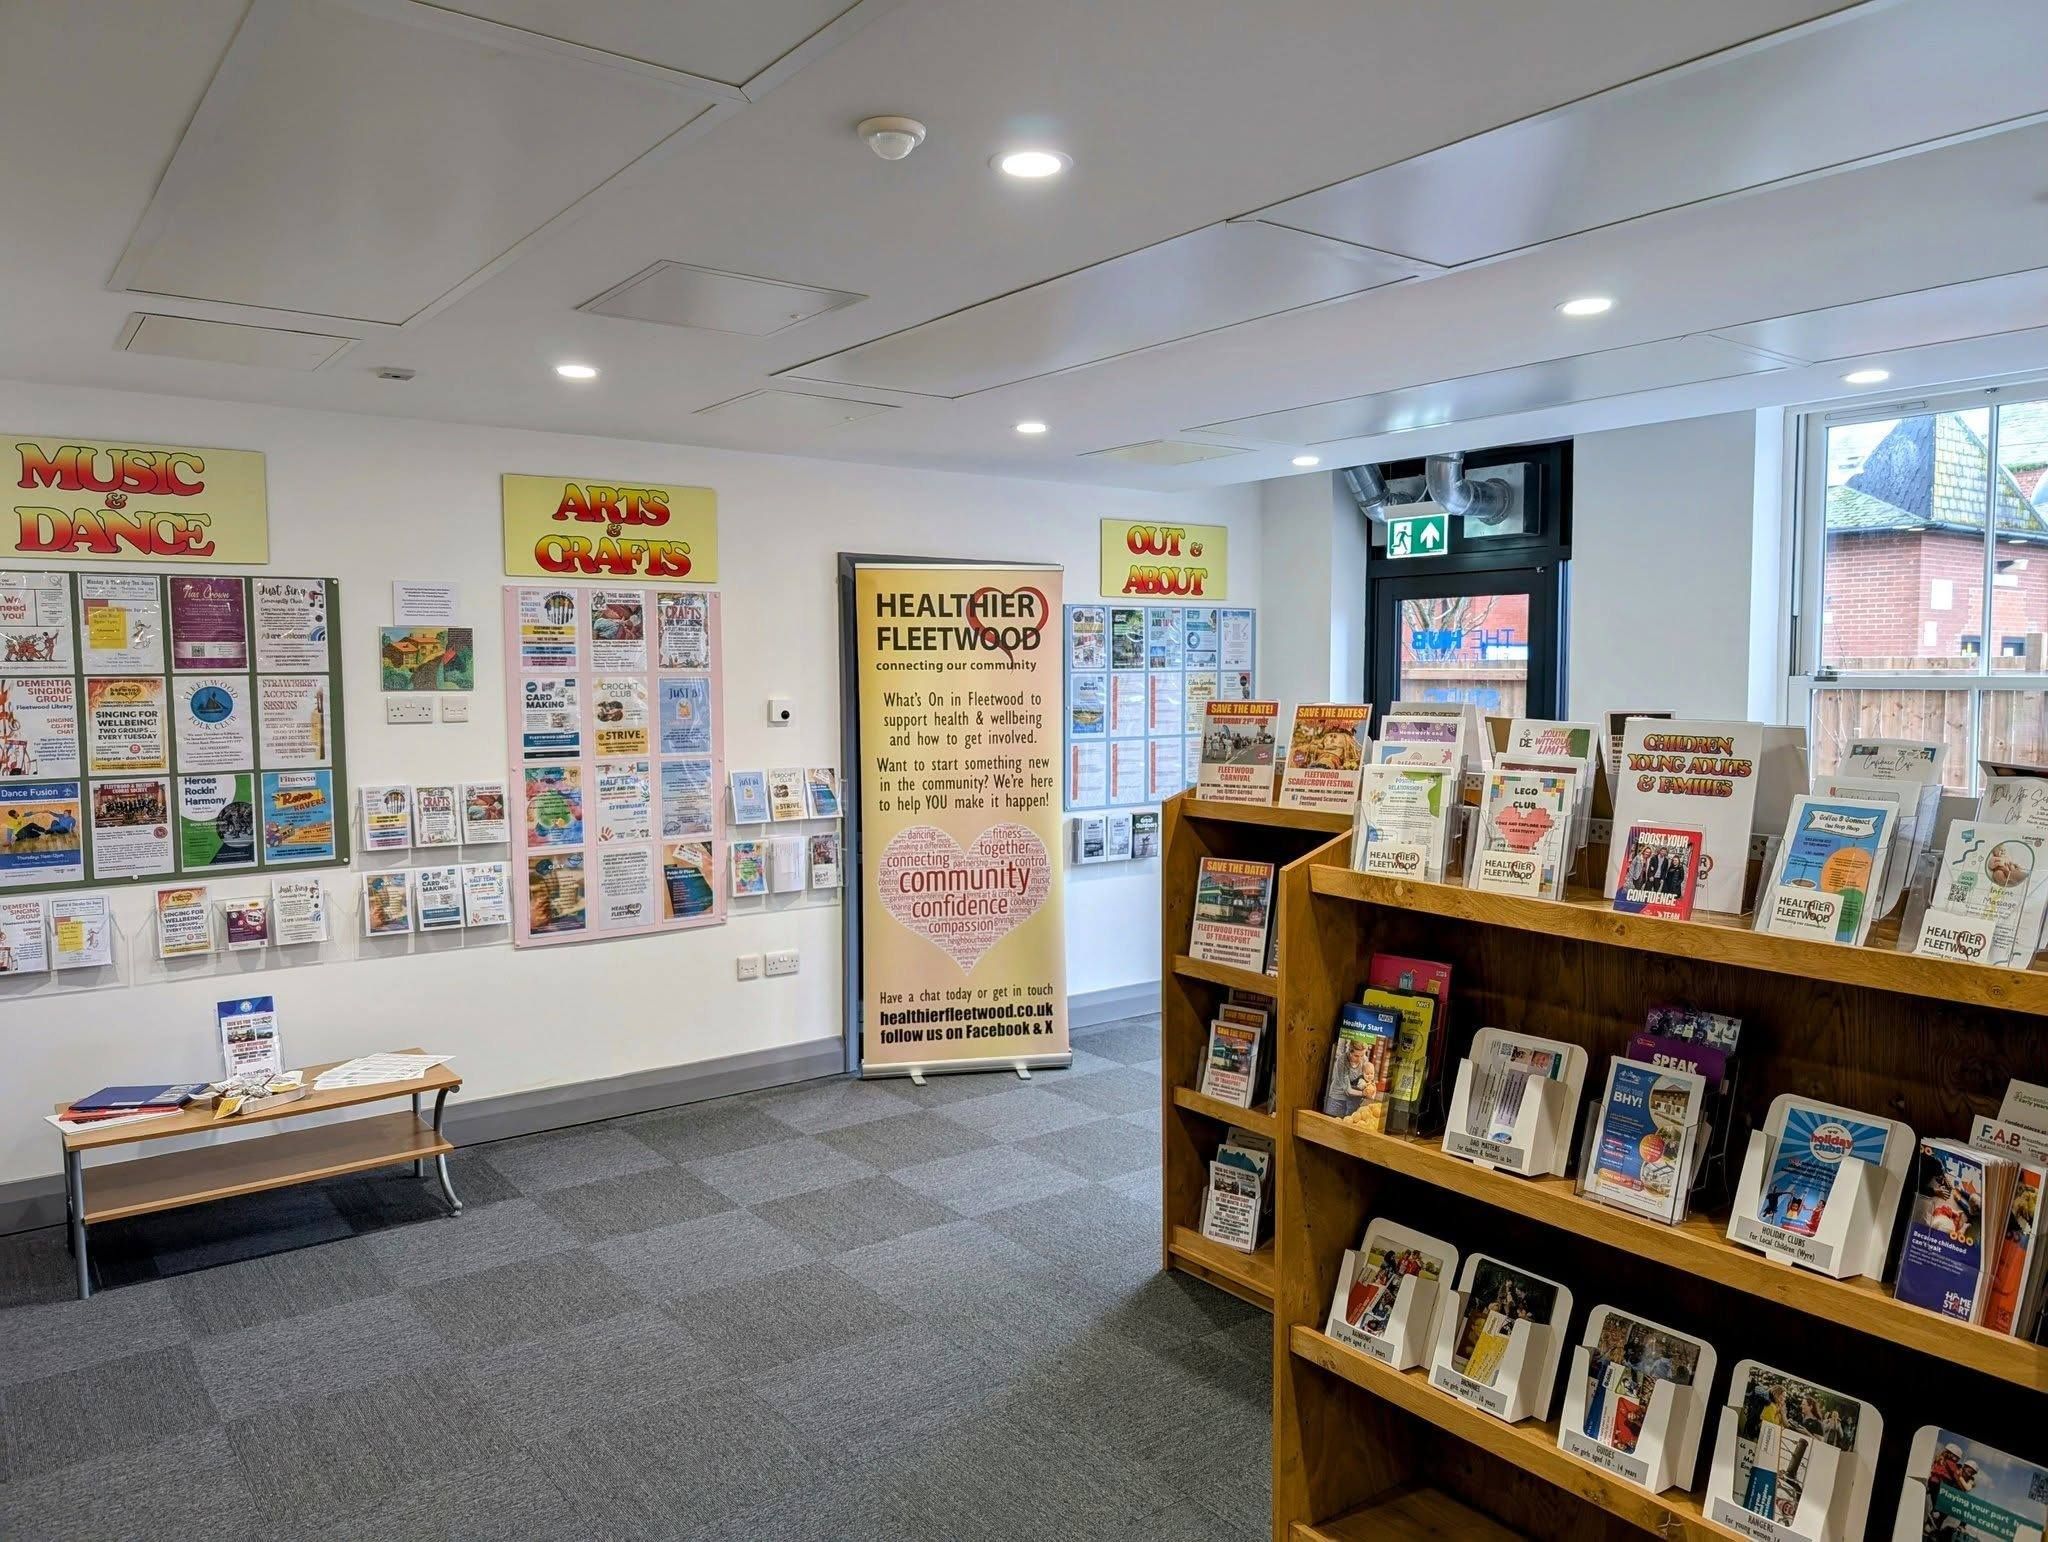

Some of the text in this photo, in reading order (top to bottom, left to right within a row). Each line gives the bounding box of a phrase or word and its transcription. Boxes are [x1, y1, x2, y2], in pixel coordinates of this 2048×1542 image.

[15, 443, 204, 496] MUSIC
[105, 493, 128, 509] &
[552, 483, 670, 526] ARTS
[14, 506, 215, 556] DANCE
[607, 523, 621, 537] &
[1127, 525, 1203, 557] OUT &
[535, 534, 692, 577] CRAFTS
[1122, 565, 1208, 595] ABOUT
[259, 585, 282, 596] Just
[876, 594, 1035, 617] HEALTHIER
[3, 612, 24, 620] you!
[878, 627, 1041, 650] FLEETWOOD
[876, 660, 1037, 673] connecting our community
[884, 691, 1041, 707] What's On in Fleetwood to
[1211, 704, 1273, 714] SAVE THE DATE!
[1298, 708, 1367, 718] SAVE THE DATES!
[188, 715, 237, 730] FOLK CLUB
[884, 711, 1042, 731] support health & wellbeing
[606, 730, 644, 740] STRIVE.
[890, 730, 1037, 749] and how to get involved.
[877, 755, 1049, 773] Want to start something new
[1218, 766, 1254, 774] FLEETWOOD
[1628, 754, 1752, 777] YOUNG ADULTS
[1288, 778, 1354, 787] SCARECROW FESTIVAL
[1304, 771, 1339, 779] FLEETWOOD
[185, 787, 217, 795] Rockin'
[880, 774, 1053, 793] in the community? We're here
[1637, 775, 1734, 797] & FAMILIES
[1, 790, 27, 798] Dance
[186, 797, 227, 806] Harmony
[879, 793, 1049, 814] to help YOU make it happen!
[1513, 801, 1536, 809] CLUB
[908, 830, 936, 841] dancing
[993, 829, 1022, 838] fitness
[1638, 832, 1689, 847] BOOST YOUR
[980, 841, 1030, 858] together
[1370, 851, 1416, 861] HEALTHIER
[887, 852, 950, 868] connecting
[953, 859, 988, 868] partnership
[1015, 855, 1047, 866] control
[1369, 860, 1416, 870] FLEETWOOD
[1485, 859, 1532, 870] HEALTHIER
[1207, 861, 1267, 876] SAVE THE DATE!
[1484, 868, 1532, 879] FLEETWOOD
[900, 860, 1030, 895] community
[913, 894, 1007, 917] confidence
[1010, 898, 1037, 907] cookery
[1626, 889, 1678, 906] CONFIDENCE
[1779, 896, 1830, 912] HEALTHIER
[1776, 907, 1830, 923] FLEETWOOD
[929, 920, 993, 934] compassion
[1198, 924, 1260, 938] FLEETWOOD FESTIVAL
[1926, 925, 1982, 946] HEALTHIER
[1924, 937, 1981, 958] FLEETWOOD
[880, 983, 1053, 1004] Have a chat today or get in touch
[880, 1002, 1053, 1025] healthierfleetwood.co.uk
[881, 1020, 1053, 1044] follow us on Facebook & X
[1343, 1019, 1383, 1032] Healthy Start
[1652, 1053, 1698, 1074] SPEAK
[1613, 1091, 1643, 1108] BHY!
[1811, 1133, 1854, 1149] holiday
[1762, 1226, 1806, 1247] HOLIDAY CLUBS
[1913, 1230, 1967, 1254] Because childhood
[1749, 1232, 1815, 1262] For Local Children (Wyre)
[1929, 1243, 1941, 1253] wait
[1942, 1300, 1969, 1316] START
[1939, 1488, 2009, 1524] Playing your part
[1748, 1515, 1774, 1533] RANGERS
[1952, 1506, 1998, 1530] on the crate
[1735, 1522, 1771, 1541] young women
